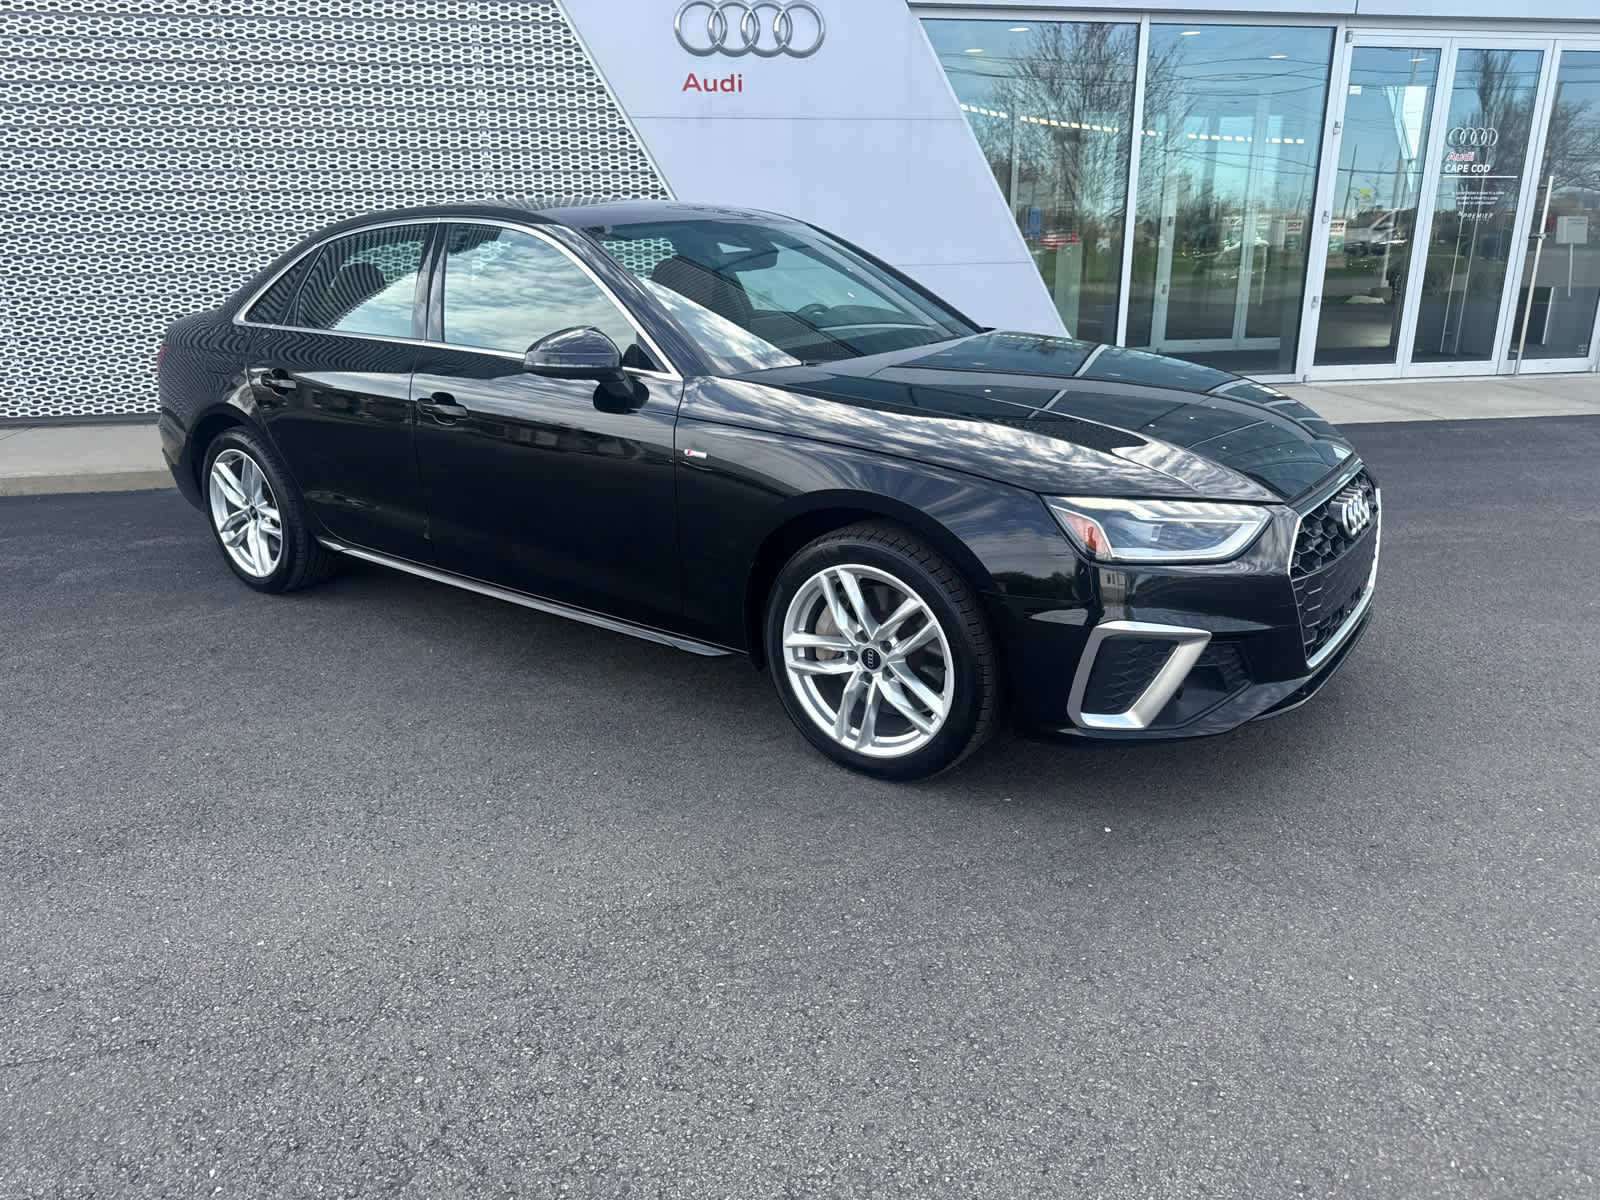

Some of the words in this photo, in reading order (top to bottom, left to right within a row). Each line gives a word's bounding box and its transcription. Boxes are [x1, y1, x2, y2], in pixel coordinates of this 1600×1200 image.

[682, 72, 743, 93] Audi
[1447, 151, 1475, 162] Audi
[1444, 164, 1469, 173] CAPE
[1471, 164, 1491, 173] COD
